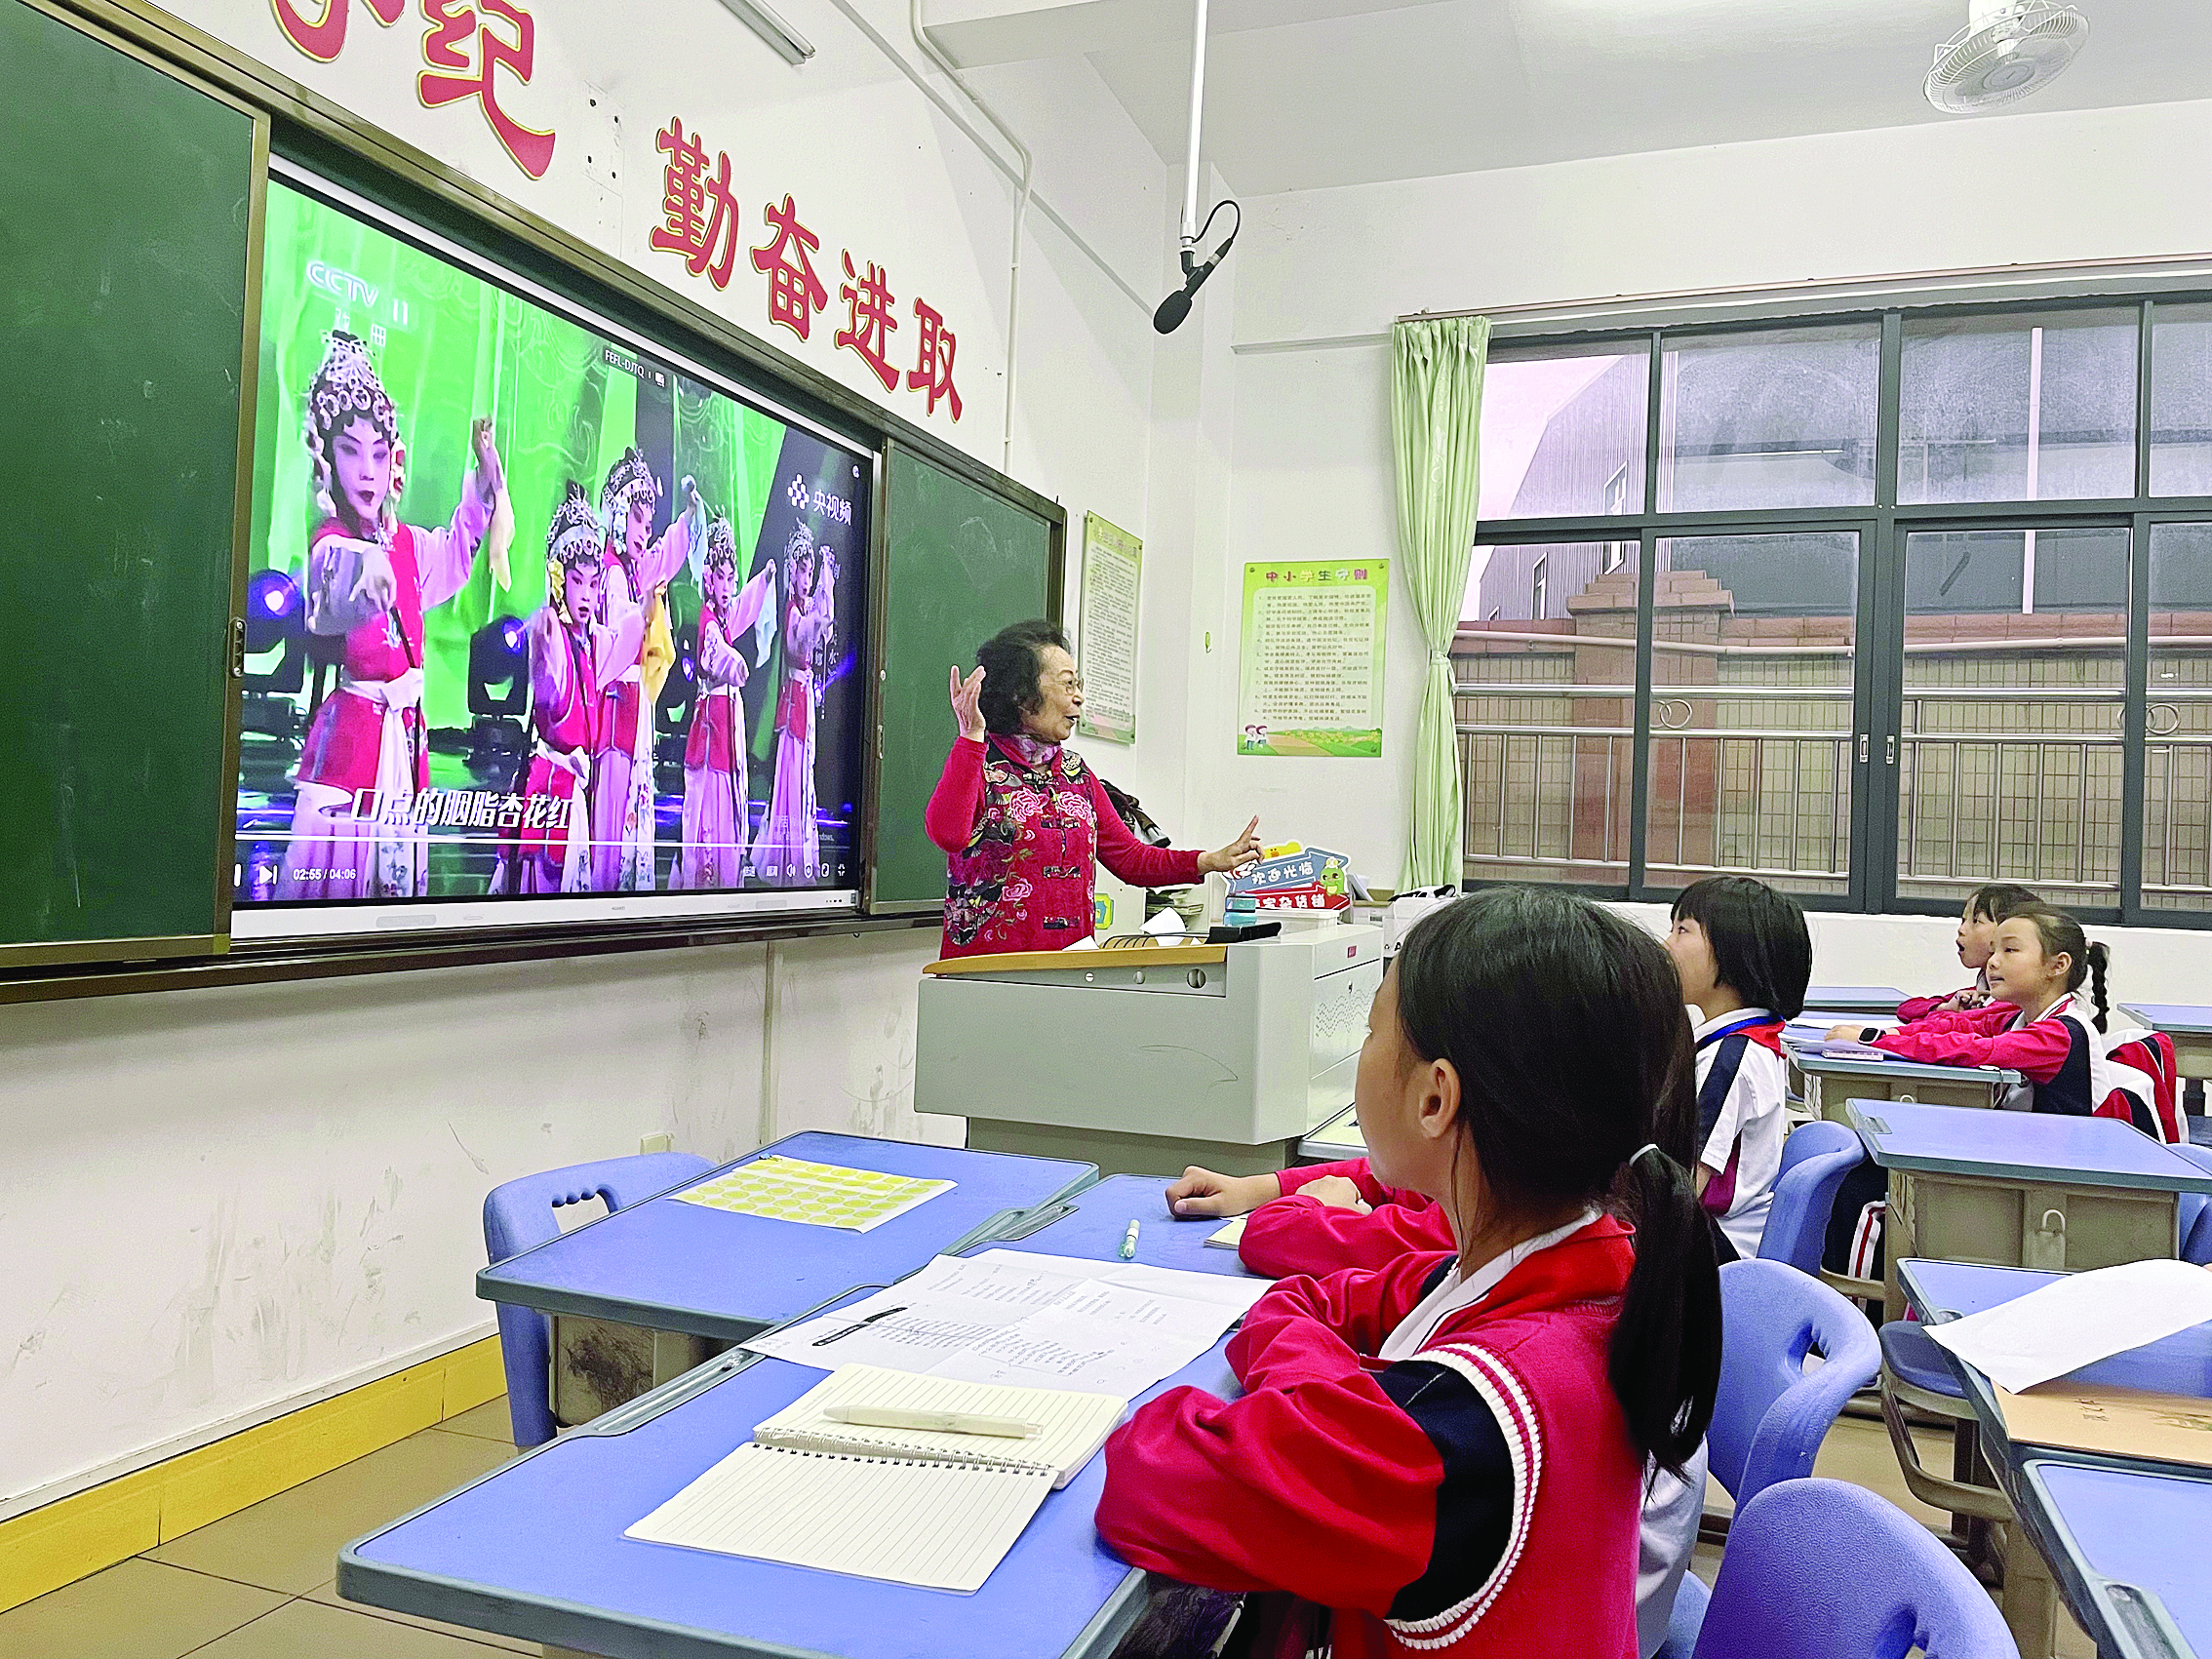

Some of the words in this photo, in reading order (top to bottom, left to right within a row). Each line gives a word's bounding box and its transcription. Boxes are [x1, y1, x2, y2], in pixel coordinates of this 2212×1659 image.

[306, 259, 379, 308] CCTV
[650, 115, 964, 423] 勤奋进取
[813, 489, 851, 527] 央视频
[1265, 568, 1368, 583] 中小学生守则
[350, 787, 573, 829] 口点的胭脂杏花红
[293, 868, 322, 881] 02:55
[329, 868, 357, 880] 04:06
[1251, 861, 1314, 886] 欢迎光临
